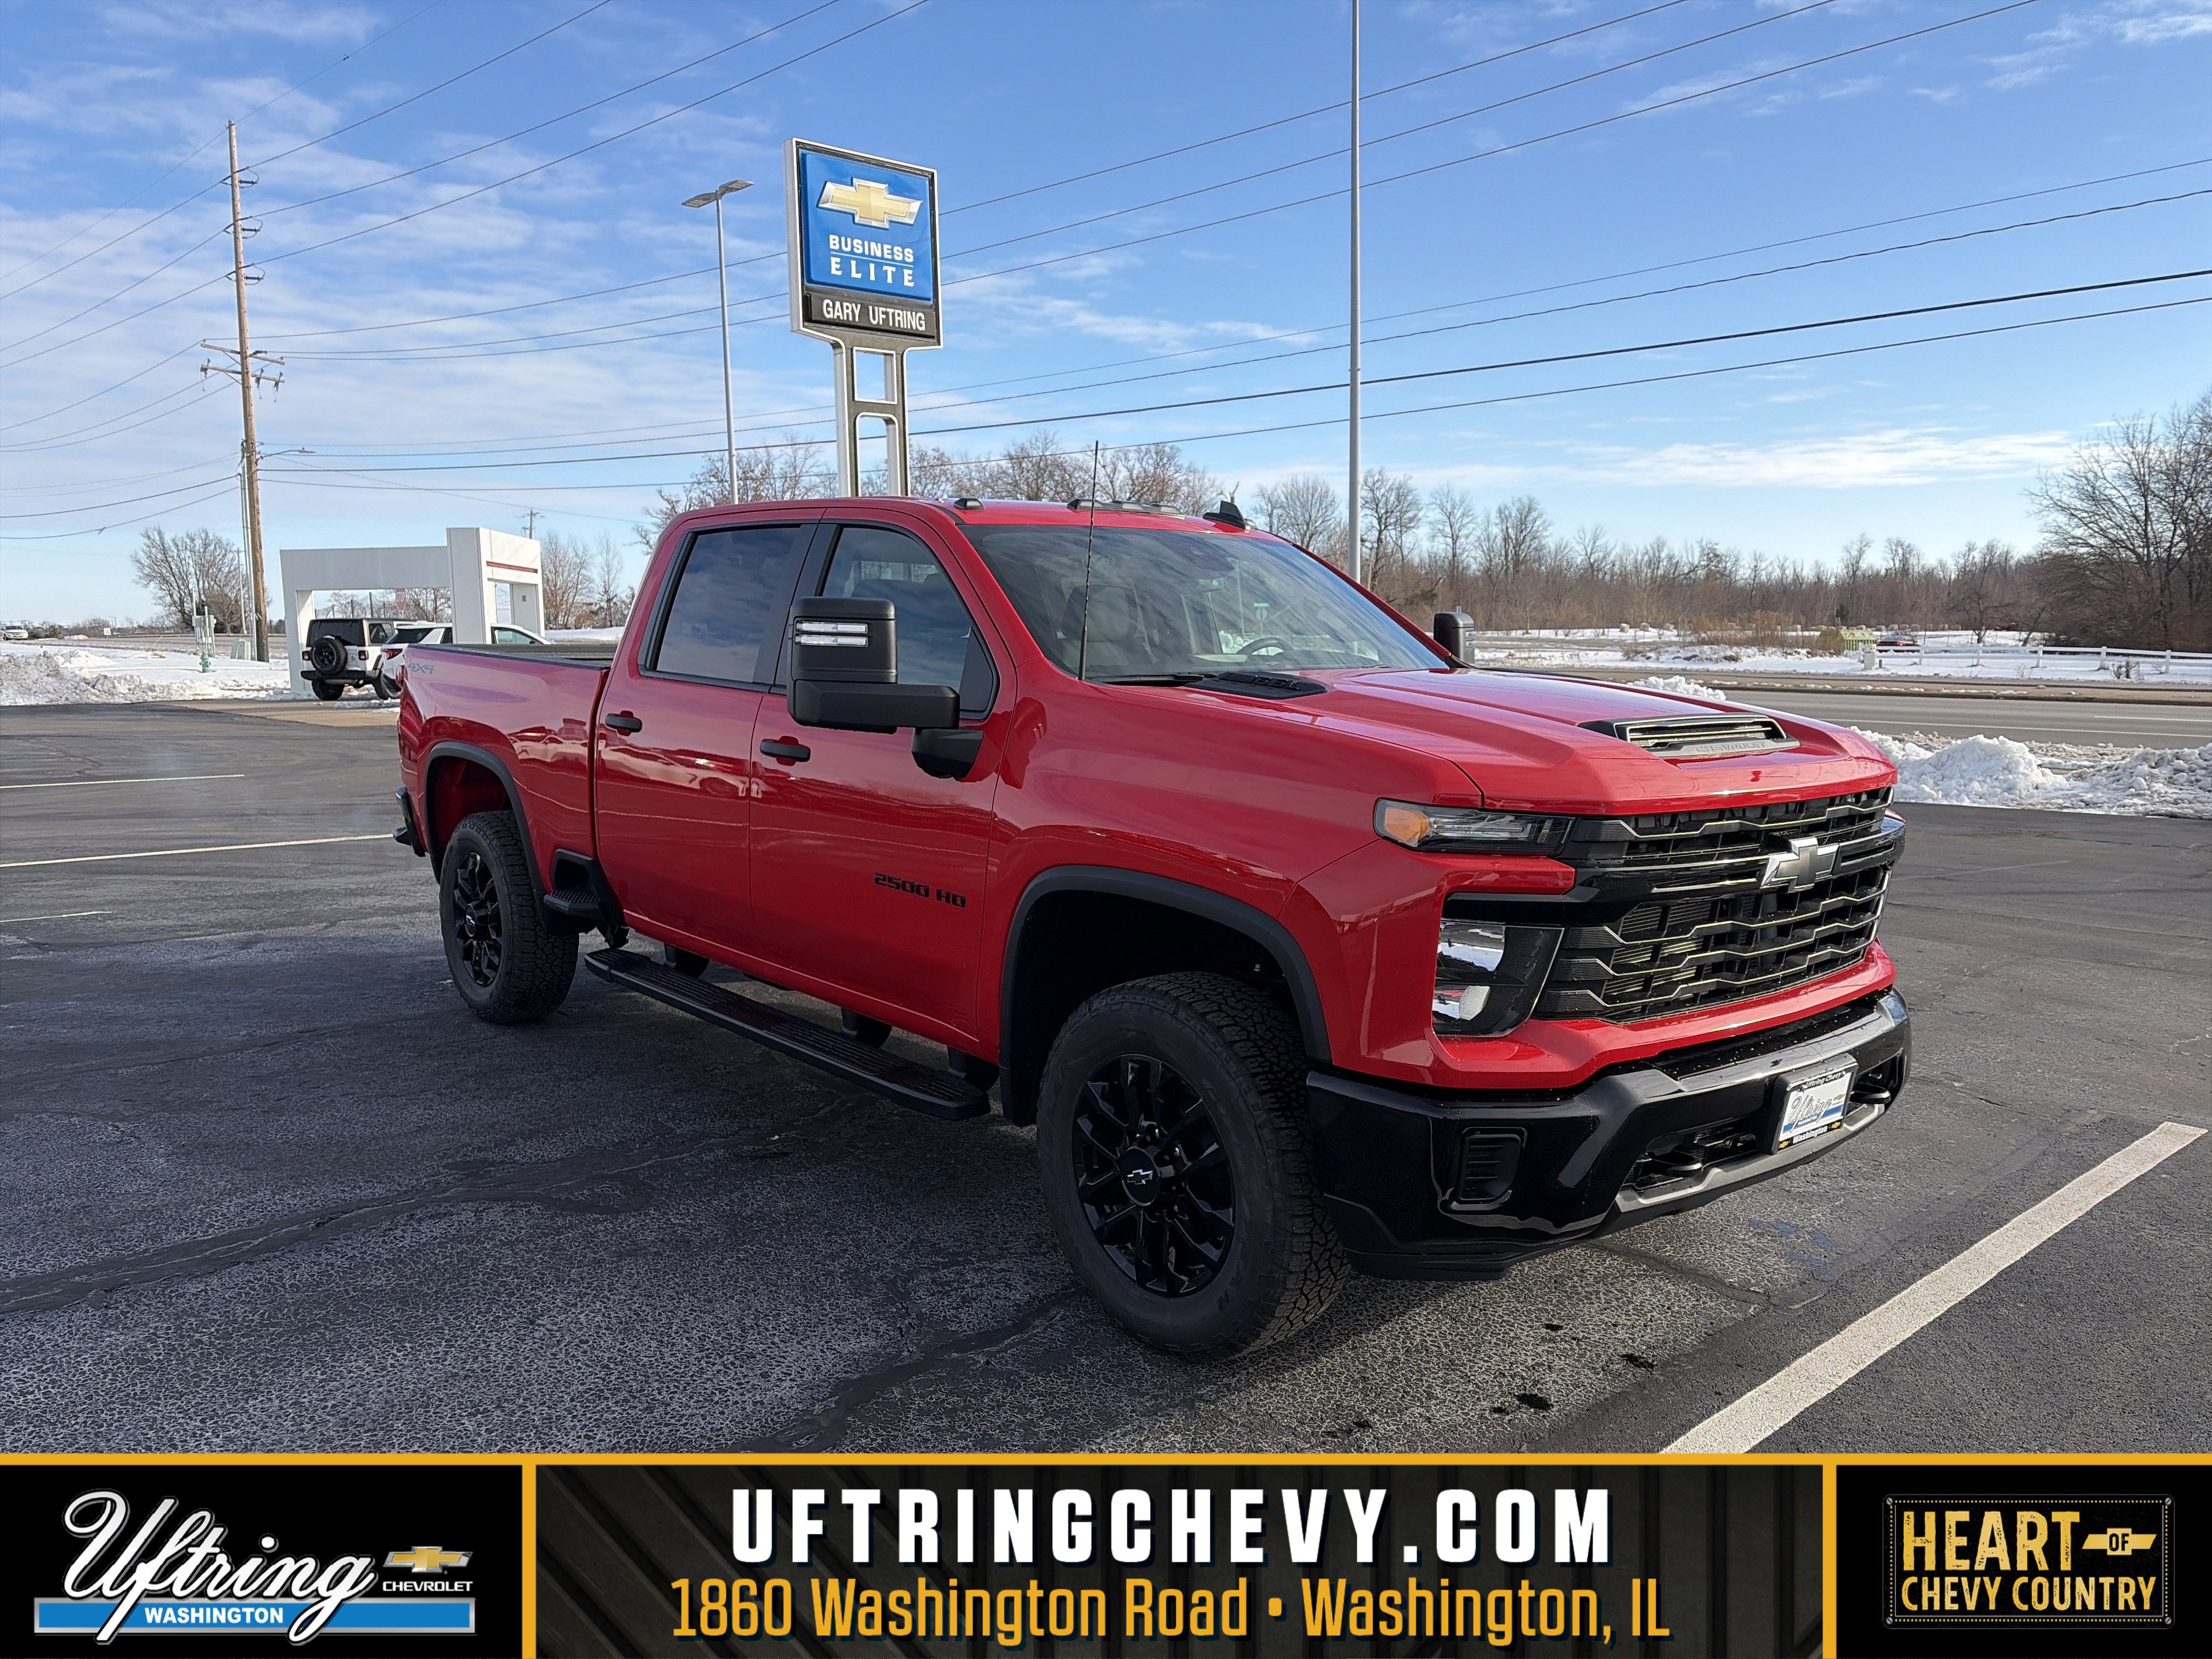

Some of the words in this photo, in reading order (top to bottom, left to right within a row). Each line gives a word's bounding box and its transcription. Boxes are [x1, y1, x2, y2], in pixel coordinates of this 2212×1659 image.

[829, 234, 914, 263] BUSINESS
[830, 257, 915, 287] ELITE
[823, 299, 861, 321] GARY
[868, 305, 926, 331] UFTRING
[396, 591, 405, 602] STOP
[874, 872, 930, 898] 2500
[936, 888, 966, 909] HD
[1788, 1094, 1832, 1133] Uftring
[1793, 1125, 1828, 1144] Washington
